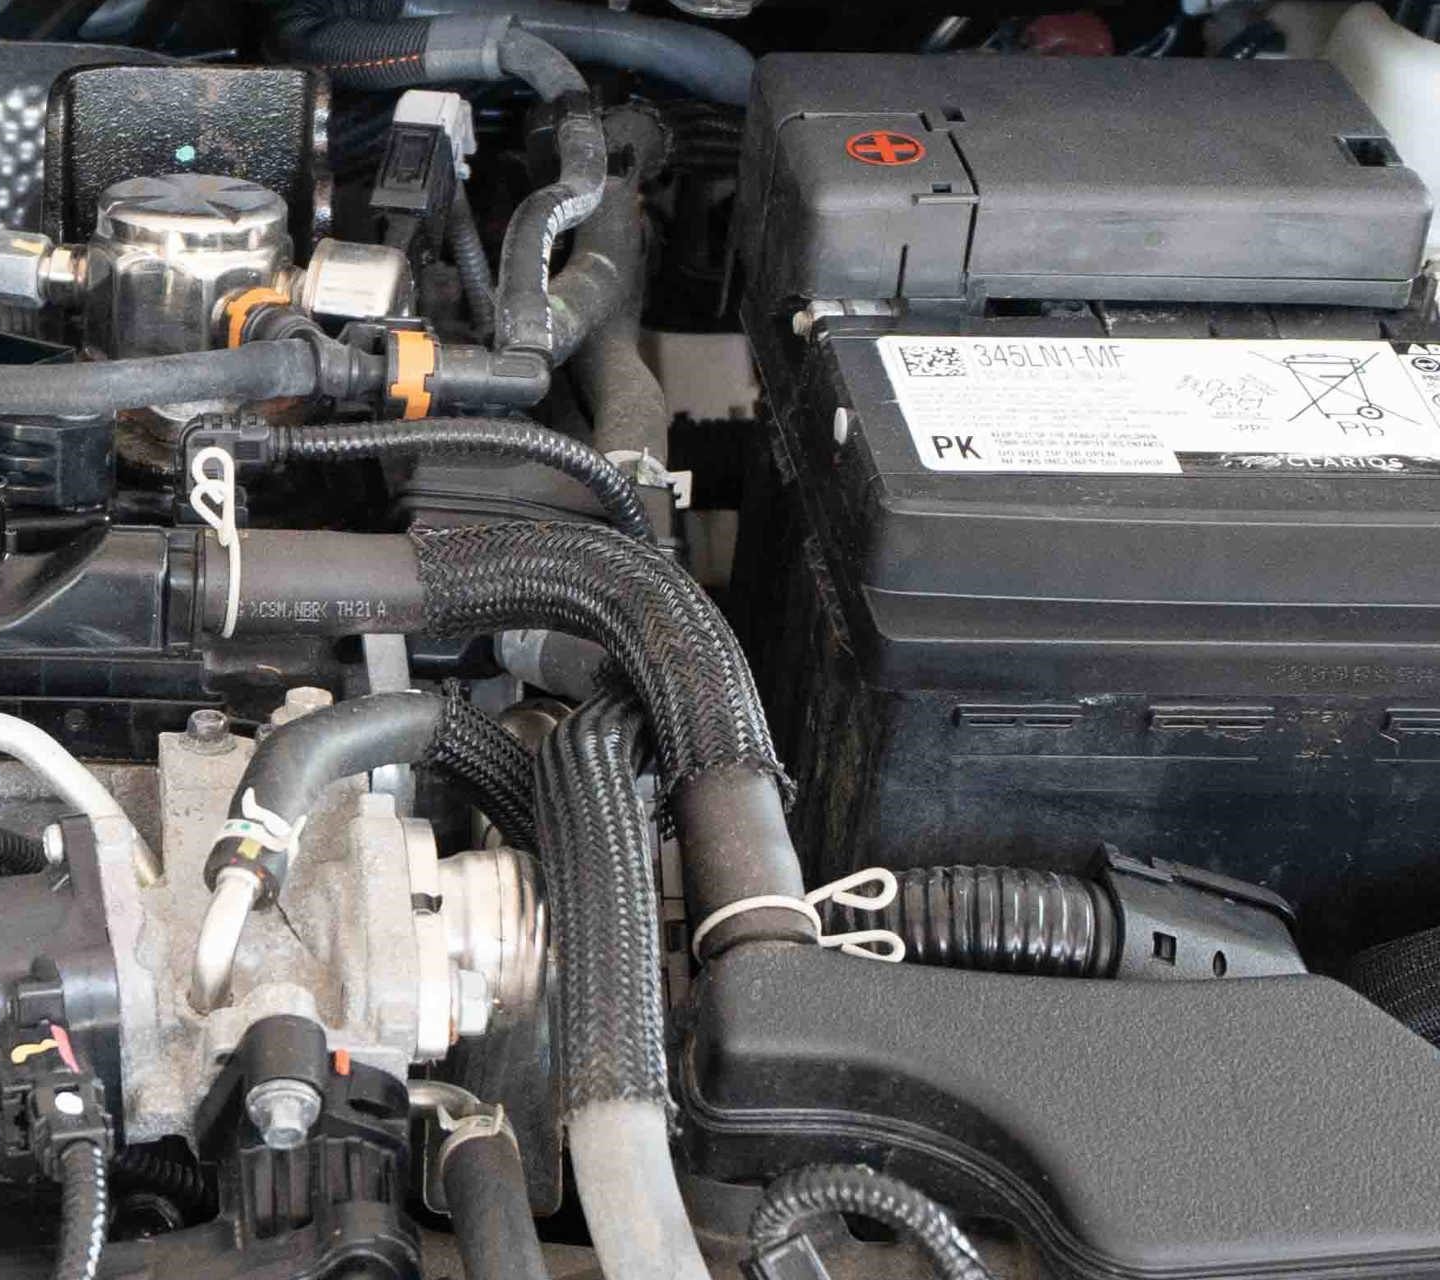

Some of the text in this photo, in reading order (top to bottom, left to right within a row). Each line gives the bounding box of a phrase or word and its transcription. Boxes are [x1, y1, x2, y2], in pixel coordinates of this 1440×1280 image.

[973, 344, 1126, 367] 345LN1-MF
[931, 435, 982, 460] PK
[1285, 456, 1406, 471] CLARIOS
